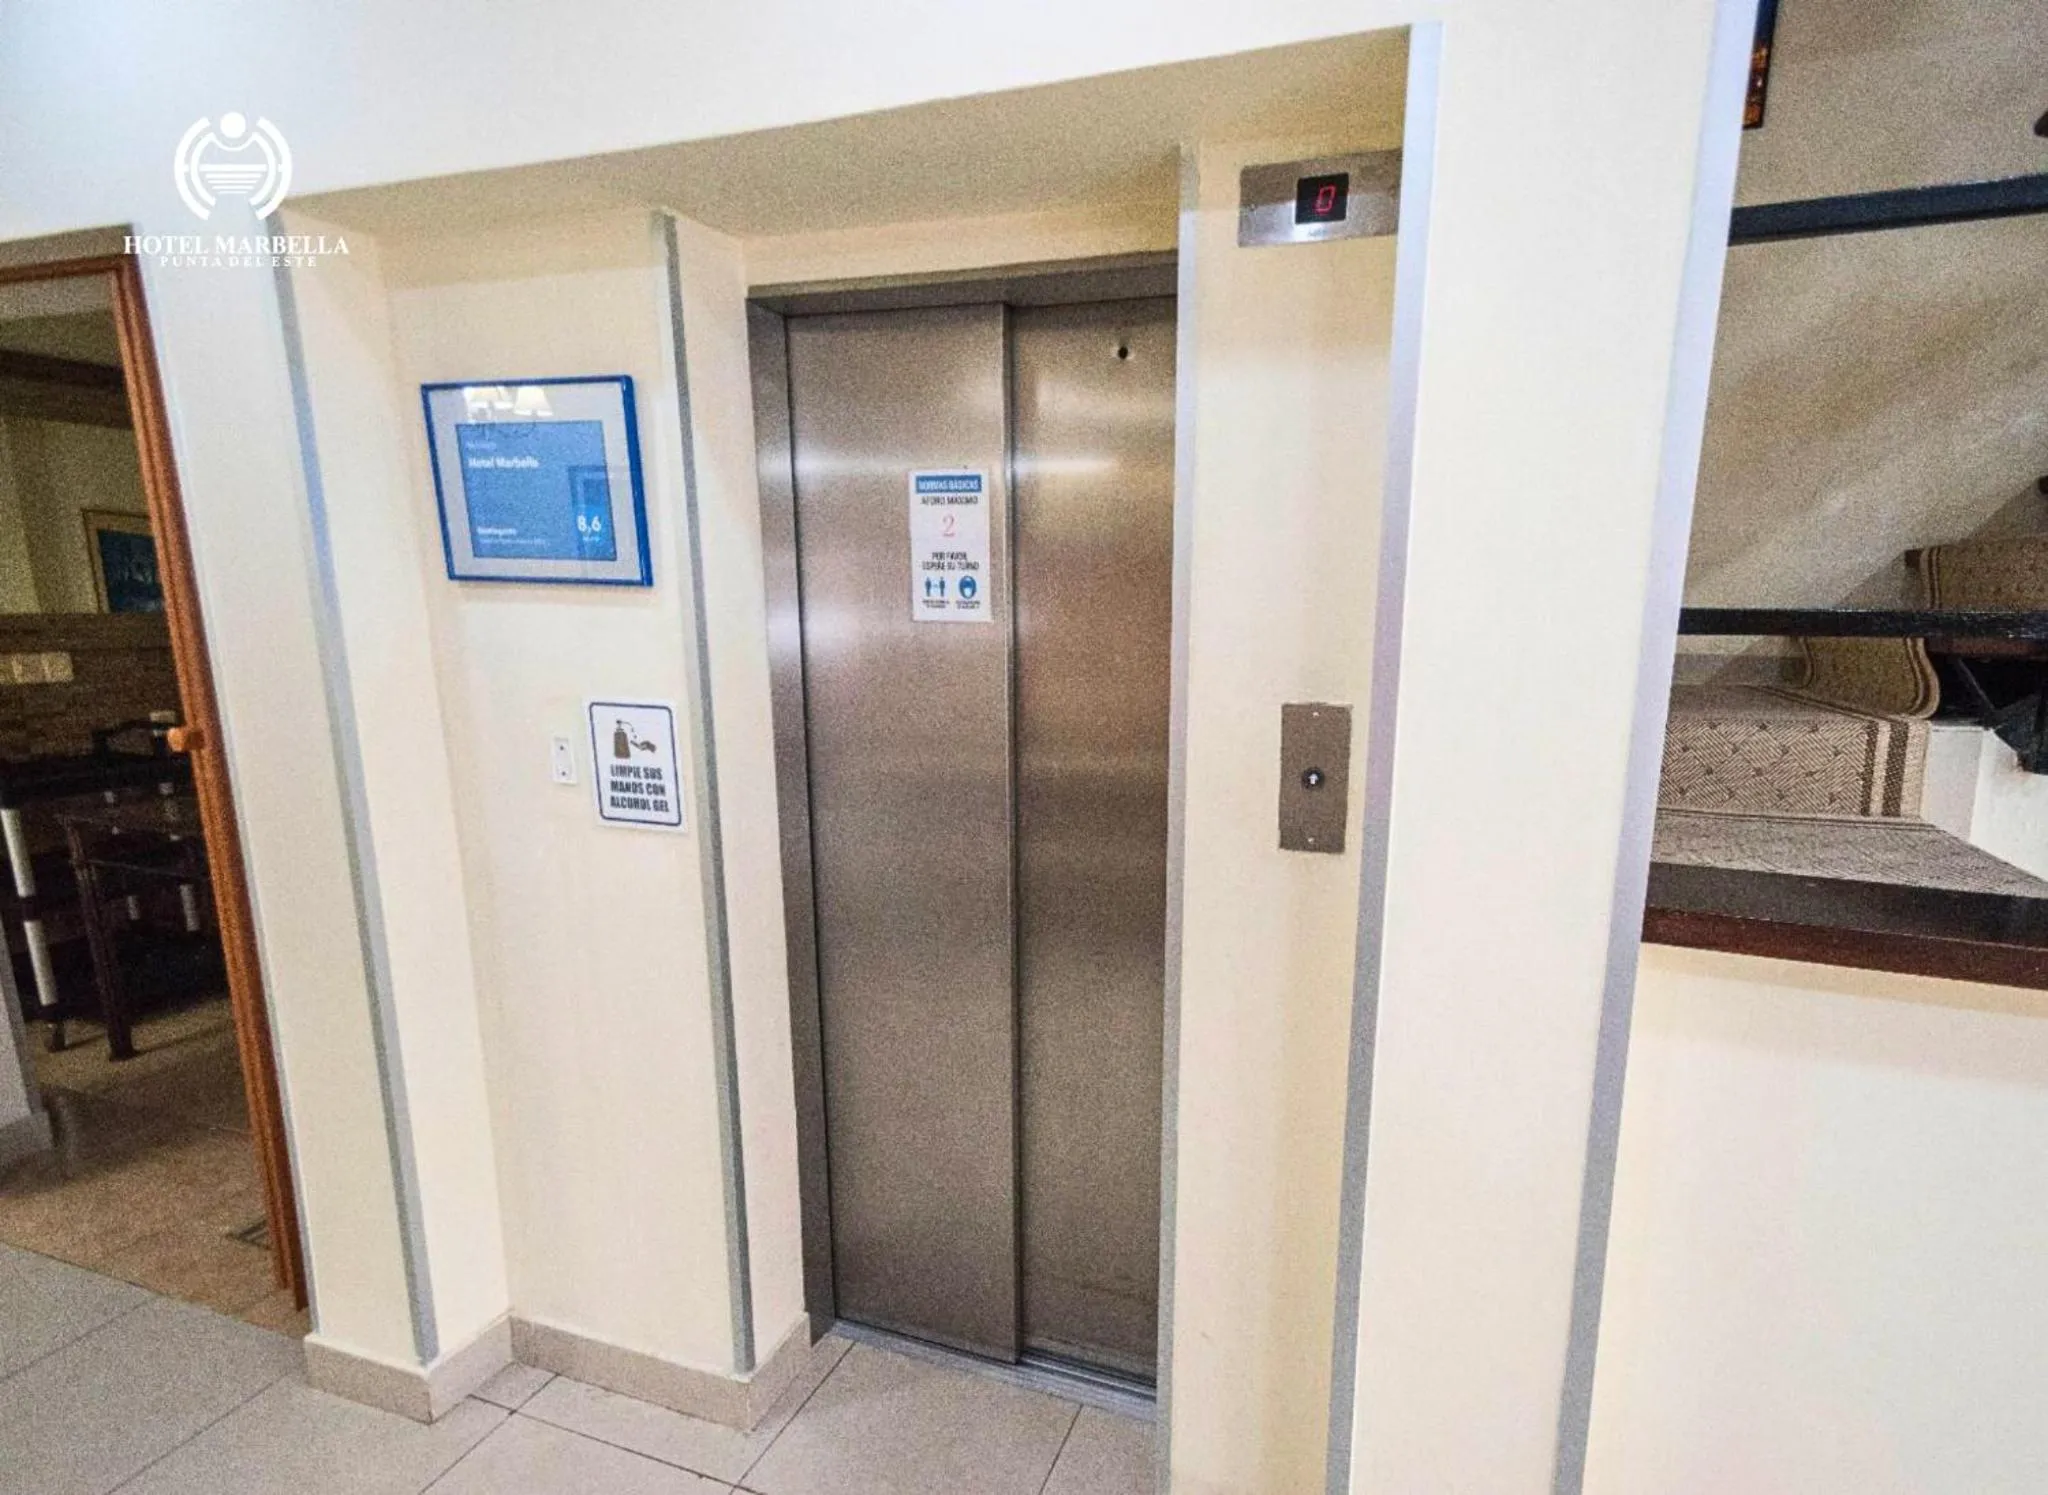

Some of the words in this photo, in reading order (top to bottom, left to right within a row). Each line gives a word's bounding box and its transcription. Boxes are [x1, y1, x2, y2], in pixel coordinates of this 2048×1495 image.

[1314, 184, 1338, 215] 0
[468, 456, 494, 469] Hotel
[495, 455, 540, 469] Marbella
[942, 514, 956, 537] 2
[610, 764, 641, 779] LIMPIE
[644, 767, 663, 780] SUS
[610, 780, 644, 795] MANOS
[645, 783, 666, 796] CON
[610, 795, 651, 811] ALCOHOL
[652, 799, 669, 812] GEL
